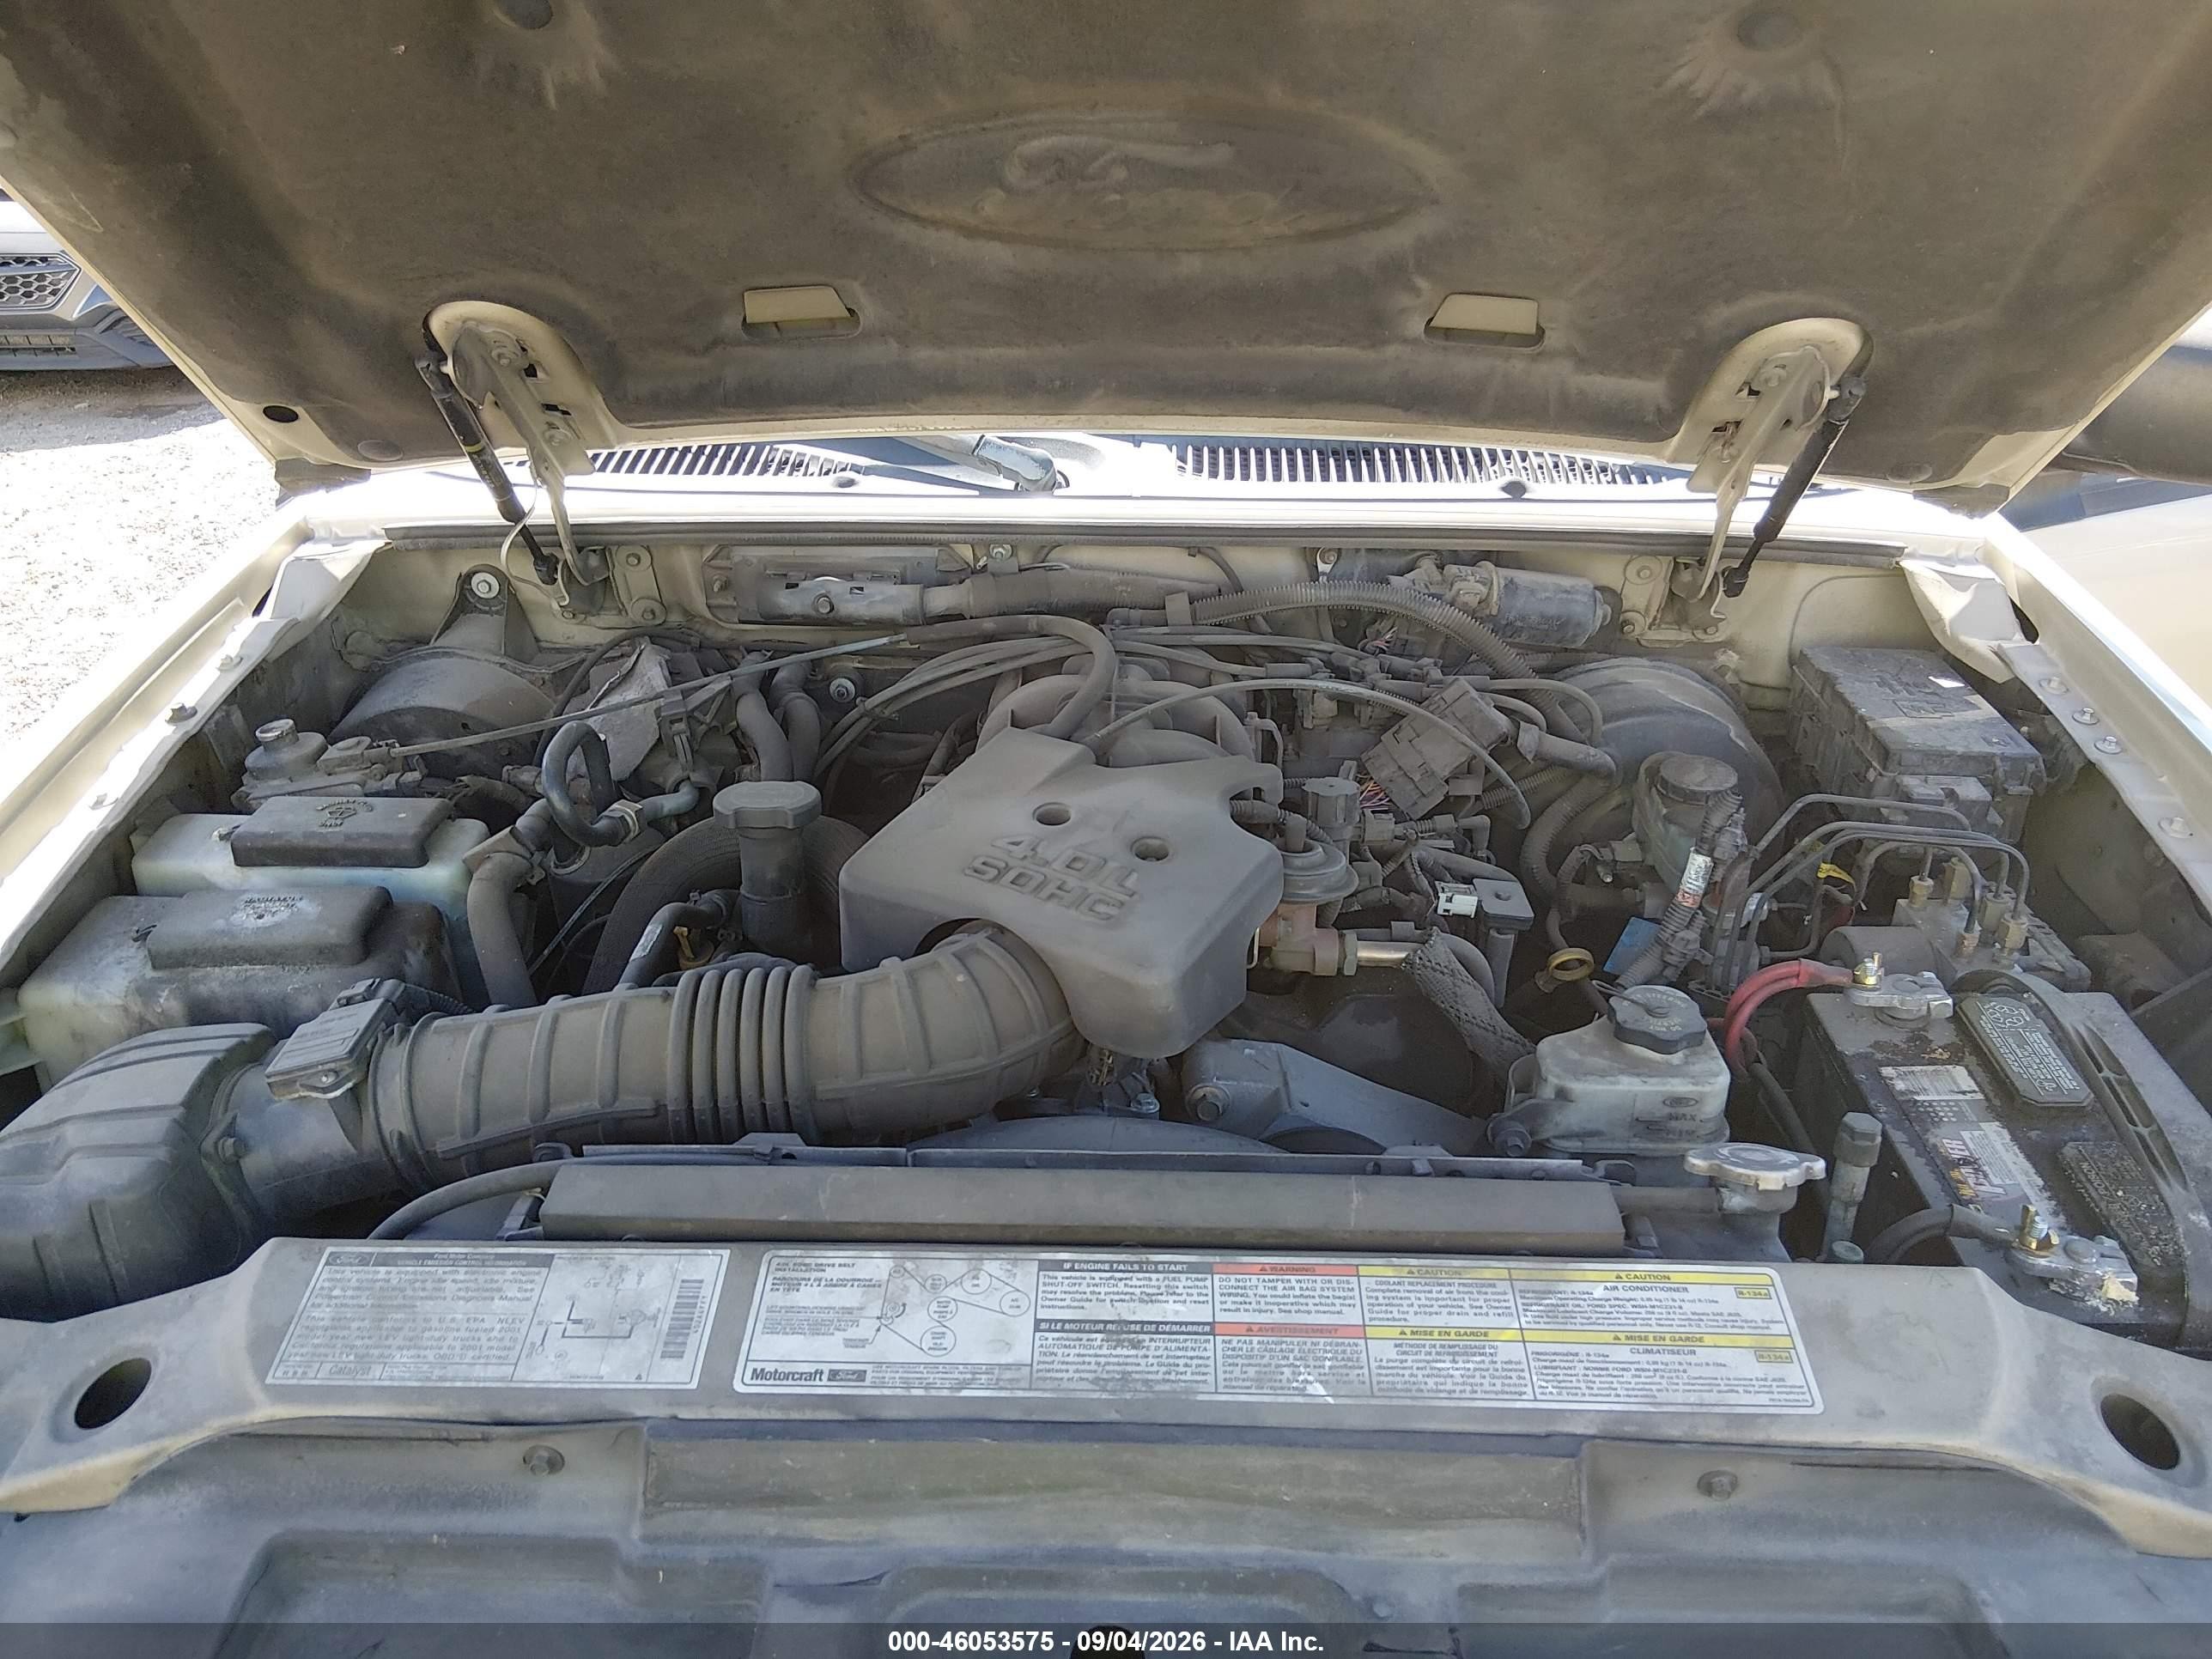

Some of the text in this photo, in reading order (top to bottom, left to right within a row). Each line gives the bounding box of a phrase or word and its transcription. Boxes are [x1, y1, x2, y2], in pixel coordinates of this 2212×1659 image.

[992, 834, 1139, 897] 4.0L
[963, 854, 1129, 922] SOHC
[1065, 1322, 1104, 1331] MOTEUR
[1630, 1347, 1697, 1356] CLIMATISEUR
[328, 1364, 371, 1376] Catalyst
[750, 1368, 823, 1382] Motorcraft
